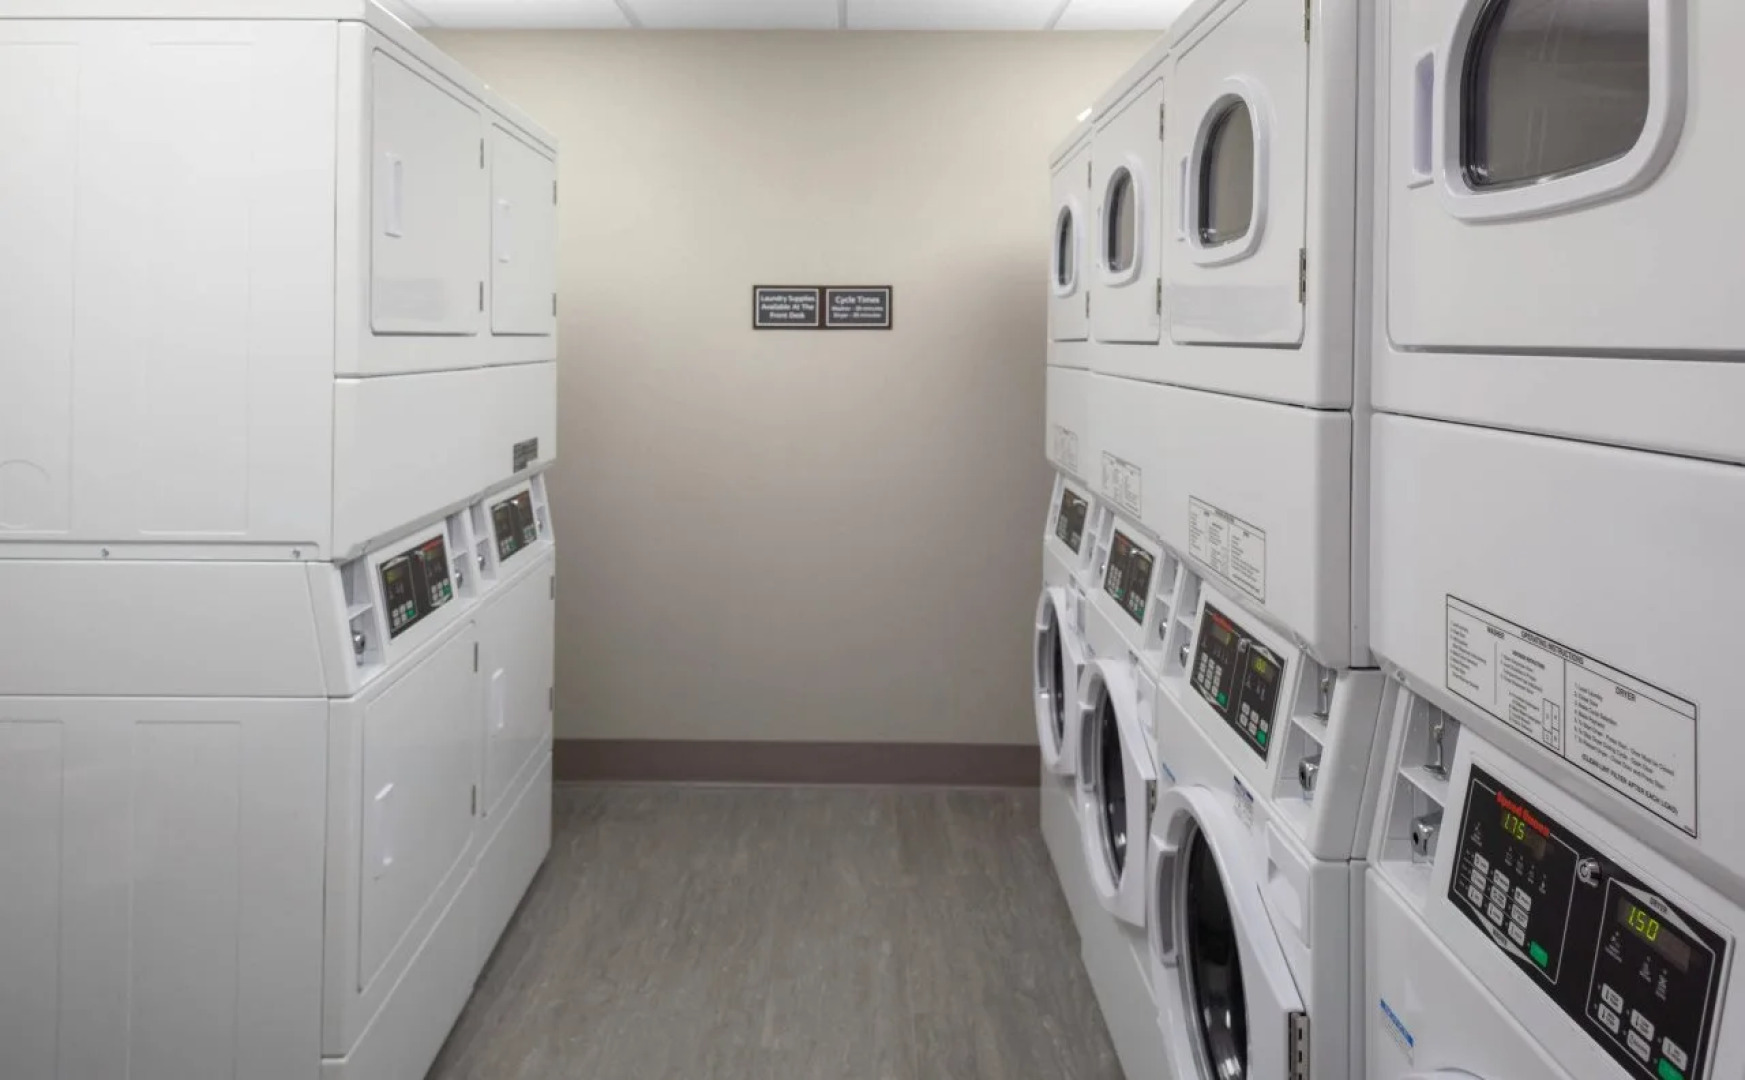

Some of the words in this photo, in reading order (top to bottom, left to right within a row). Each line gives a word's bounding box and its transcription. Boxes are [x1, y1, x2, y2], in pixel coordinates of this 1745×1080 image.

[761, 295, 788, 304] Laundry
[788, 295, 815, 303] Supplies
[835, 295, 856, 305] Cycle
[857, 295, 880, 304] Times
[761, 303, 791, 311] Available
[792, 303, 800, 311] At
[802, 303, 815, 311] The
[769, 311, 788, 319] Front
[789, 311, 806, 319] Desk
[1548, 643, 1583, 665] INSTRUCTIONS
[1615, 686, 1636, 703] DRYER
[1627, 906, 1659, 942] 1.50
